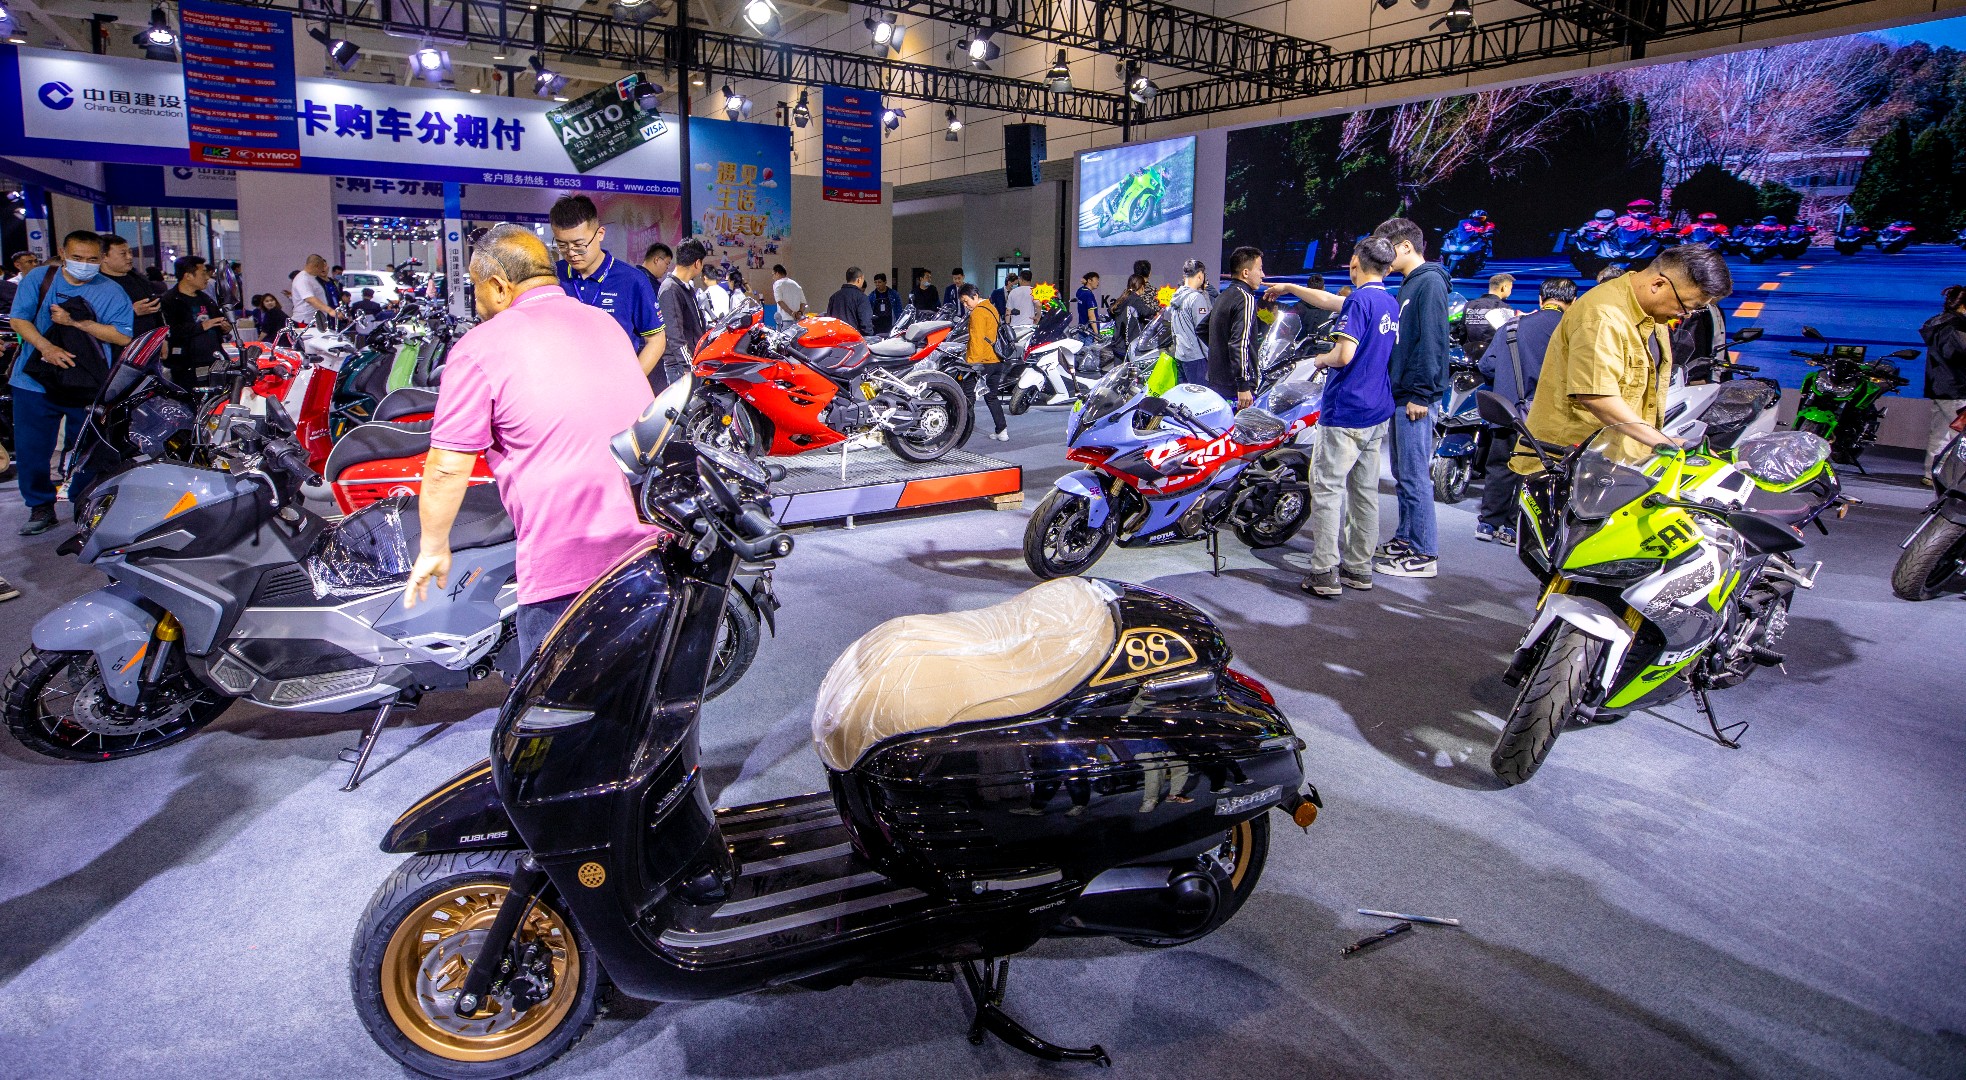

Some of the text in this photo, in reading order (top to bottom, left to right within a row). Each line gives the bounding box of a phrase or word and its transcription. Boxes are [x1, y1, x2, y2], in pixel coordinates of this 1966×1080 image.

[84, 102, 116, 112] China
[119, 105, 184, 118] Construction
[300, 99, 525, 151] 卡购车分期付
[562, 104, 623, 145] AUTO
[643, 122, 665, 137] VISA
[257, 152, 297, 160] KYMCO
[483, 172, 680, 194] 客户服务热线： 95533 网址： www.ccb.com
[715, 187, 757, 212] 生活
[714, 212, 769, 236] 小美好
[1151, 531, 1177, 542] MOTUL
[1125, 633, 1170, 671] 88
[111, 656, 127, 671] GT
